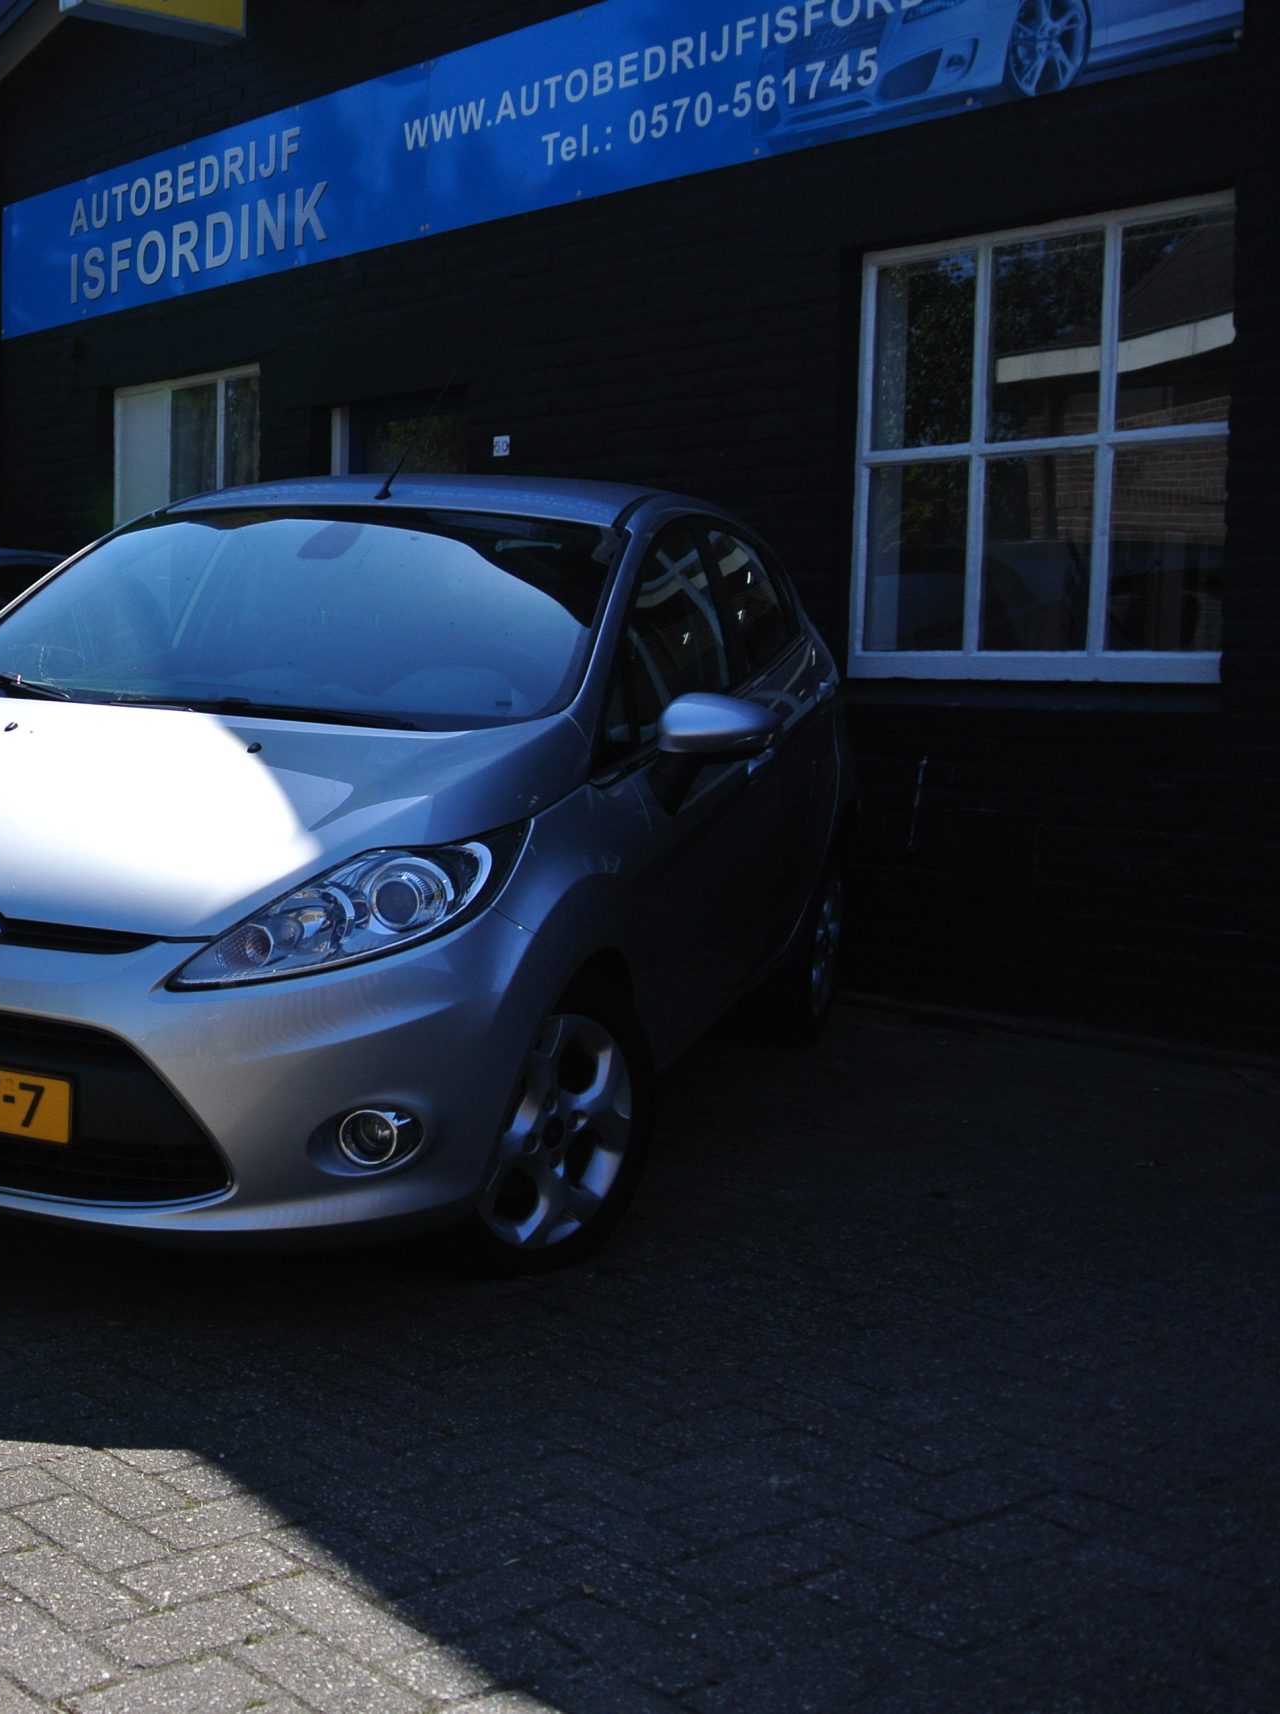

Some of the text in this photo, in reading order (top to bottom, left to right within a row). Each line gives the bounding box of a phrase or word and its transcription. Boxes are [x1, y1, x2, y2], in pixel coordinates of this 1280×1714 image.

[403, 0, 922, 151] WWW.AUTOBEDRIJFISFO
[542, 47, 879, 166] Tel.: 0570-561745
[69, 127, 301, 237] AUTOBEDRIJF
[70, 181, 329, 304] ISFORDINK
